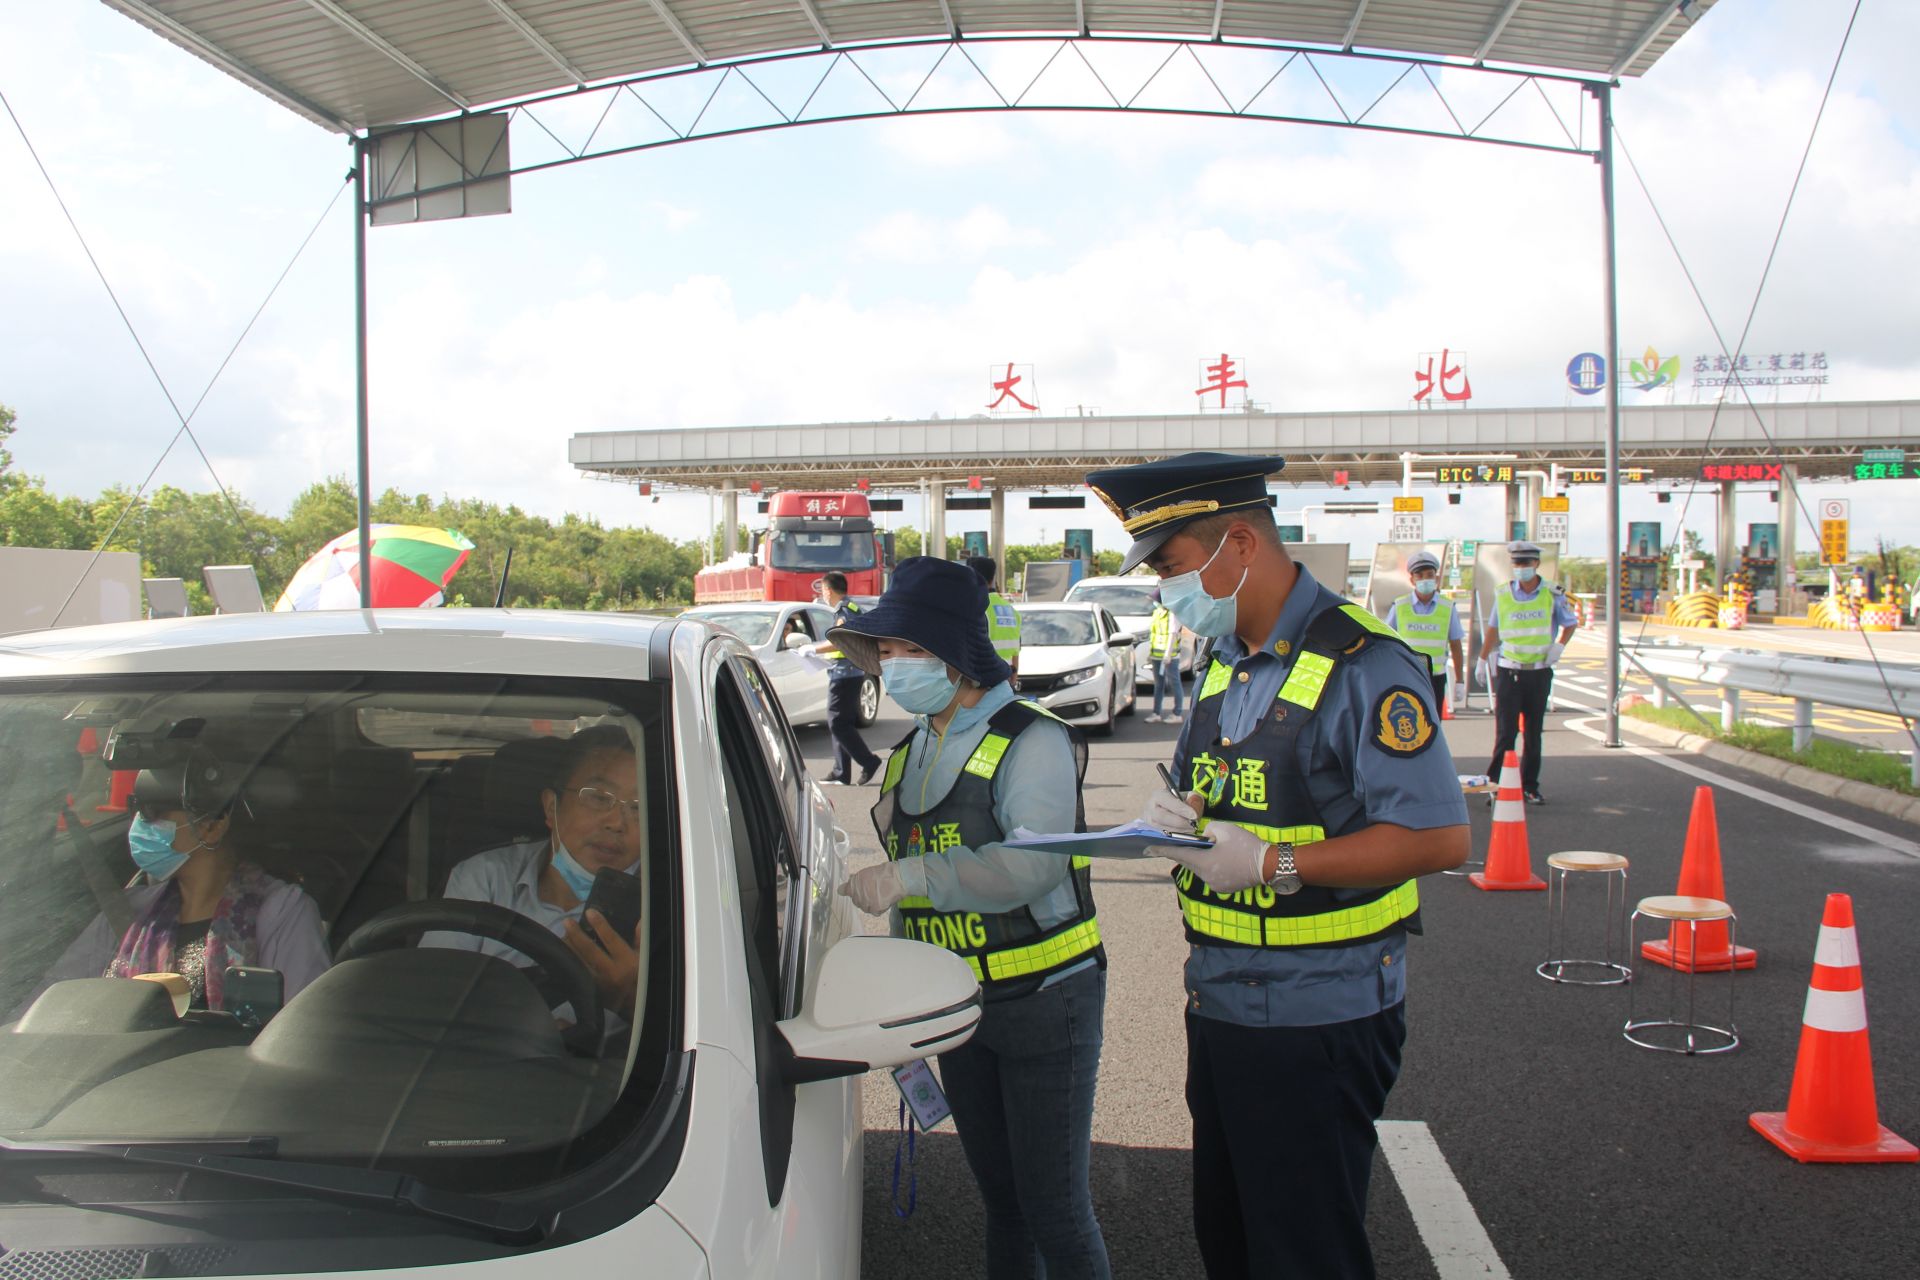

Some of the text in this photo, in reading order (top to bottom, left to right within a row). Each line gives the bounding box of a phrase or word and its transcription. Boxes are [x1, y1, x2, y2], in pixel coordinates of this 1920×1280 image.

[1440, 468, 1472, 482] ETC
[1855, 462, 1904, 480] 客货车
[1511, 610, 1544, 620] POLICE
[1407, 623, 1438, 631] POLICE
[1192, 752, 1268, 810] 交通
